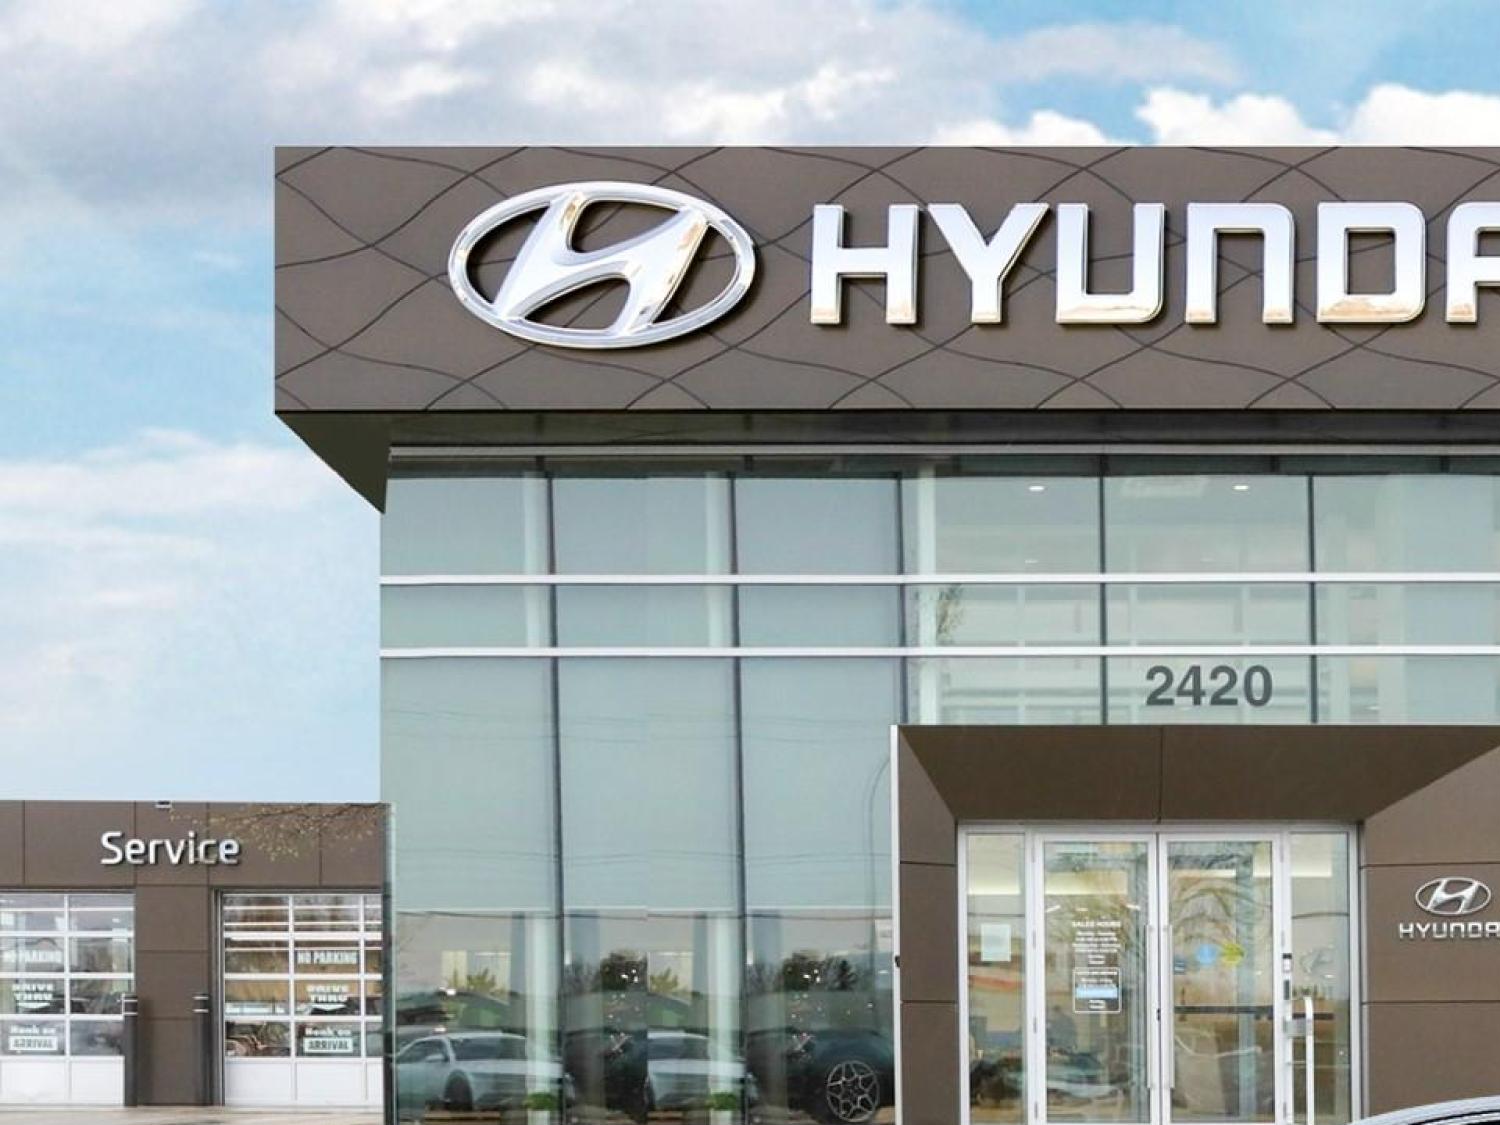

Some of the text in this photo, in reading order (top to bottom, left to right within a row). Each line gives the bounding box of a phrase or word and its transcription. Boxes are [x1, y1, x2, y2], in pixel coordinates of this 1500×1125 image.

[1145, 664, 1273, 706] 2420
[99, 830, 241, 865] Service
[313, 950, 358, 965] PARKING
[308, 1040, 350, 1051] ARRIVAL
